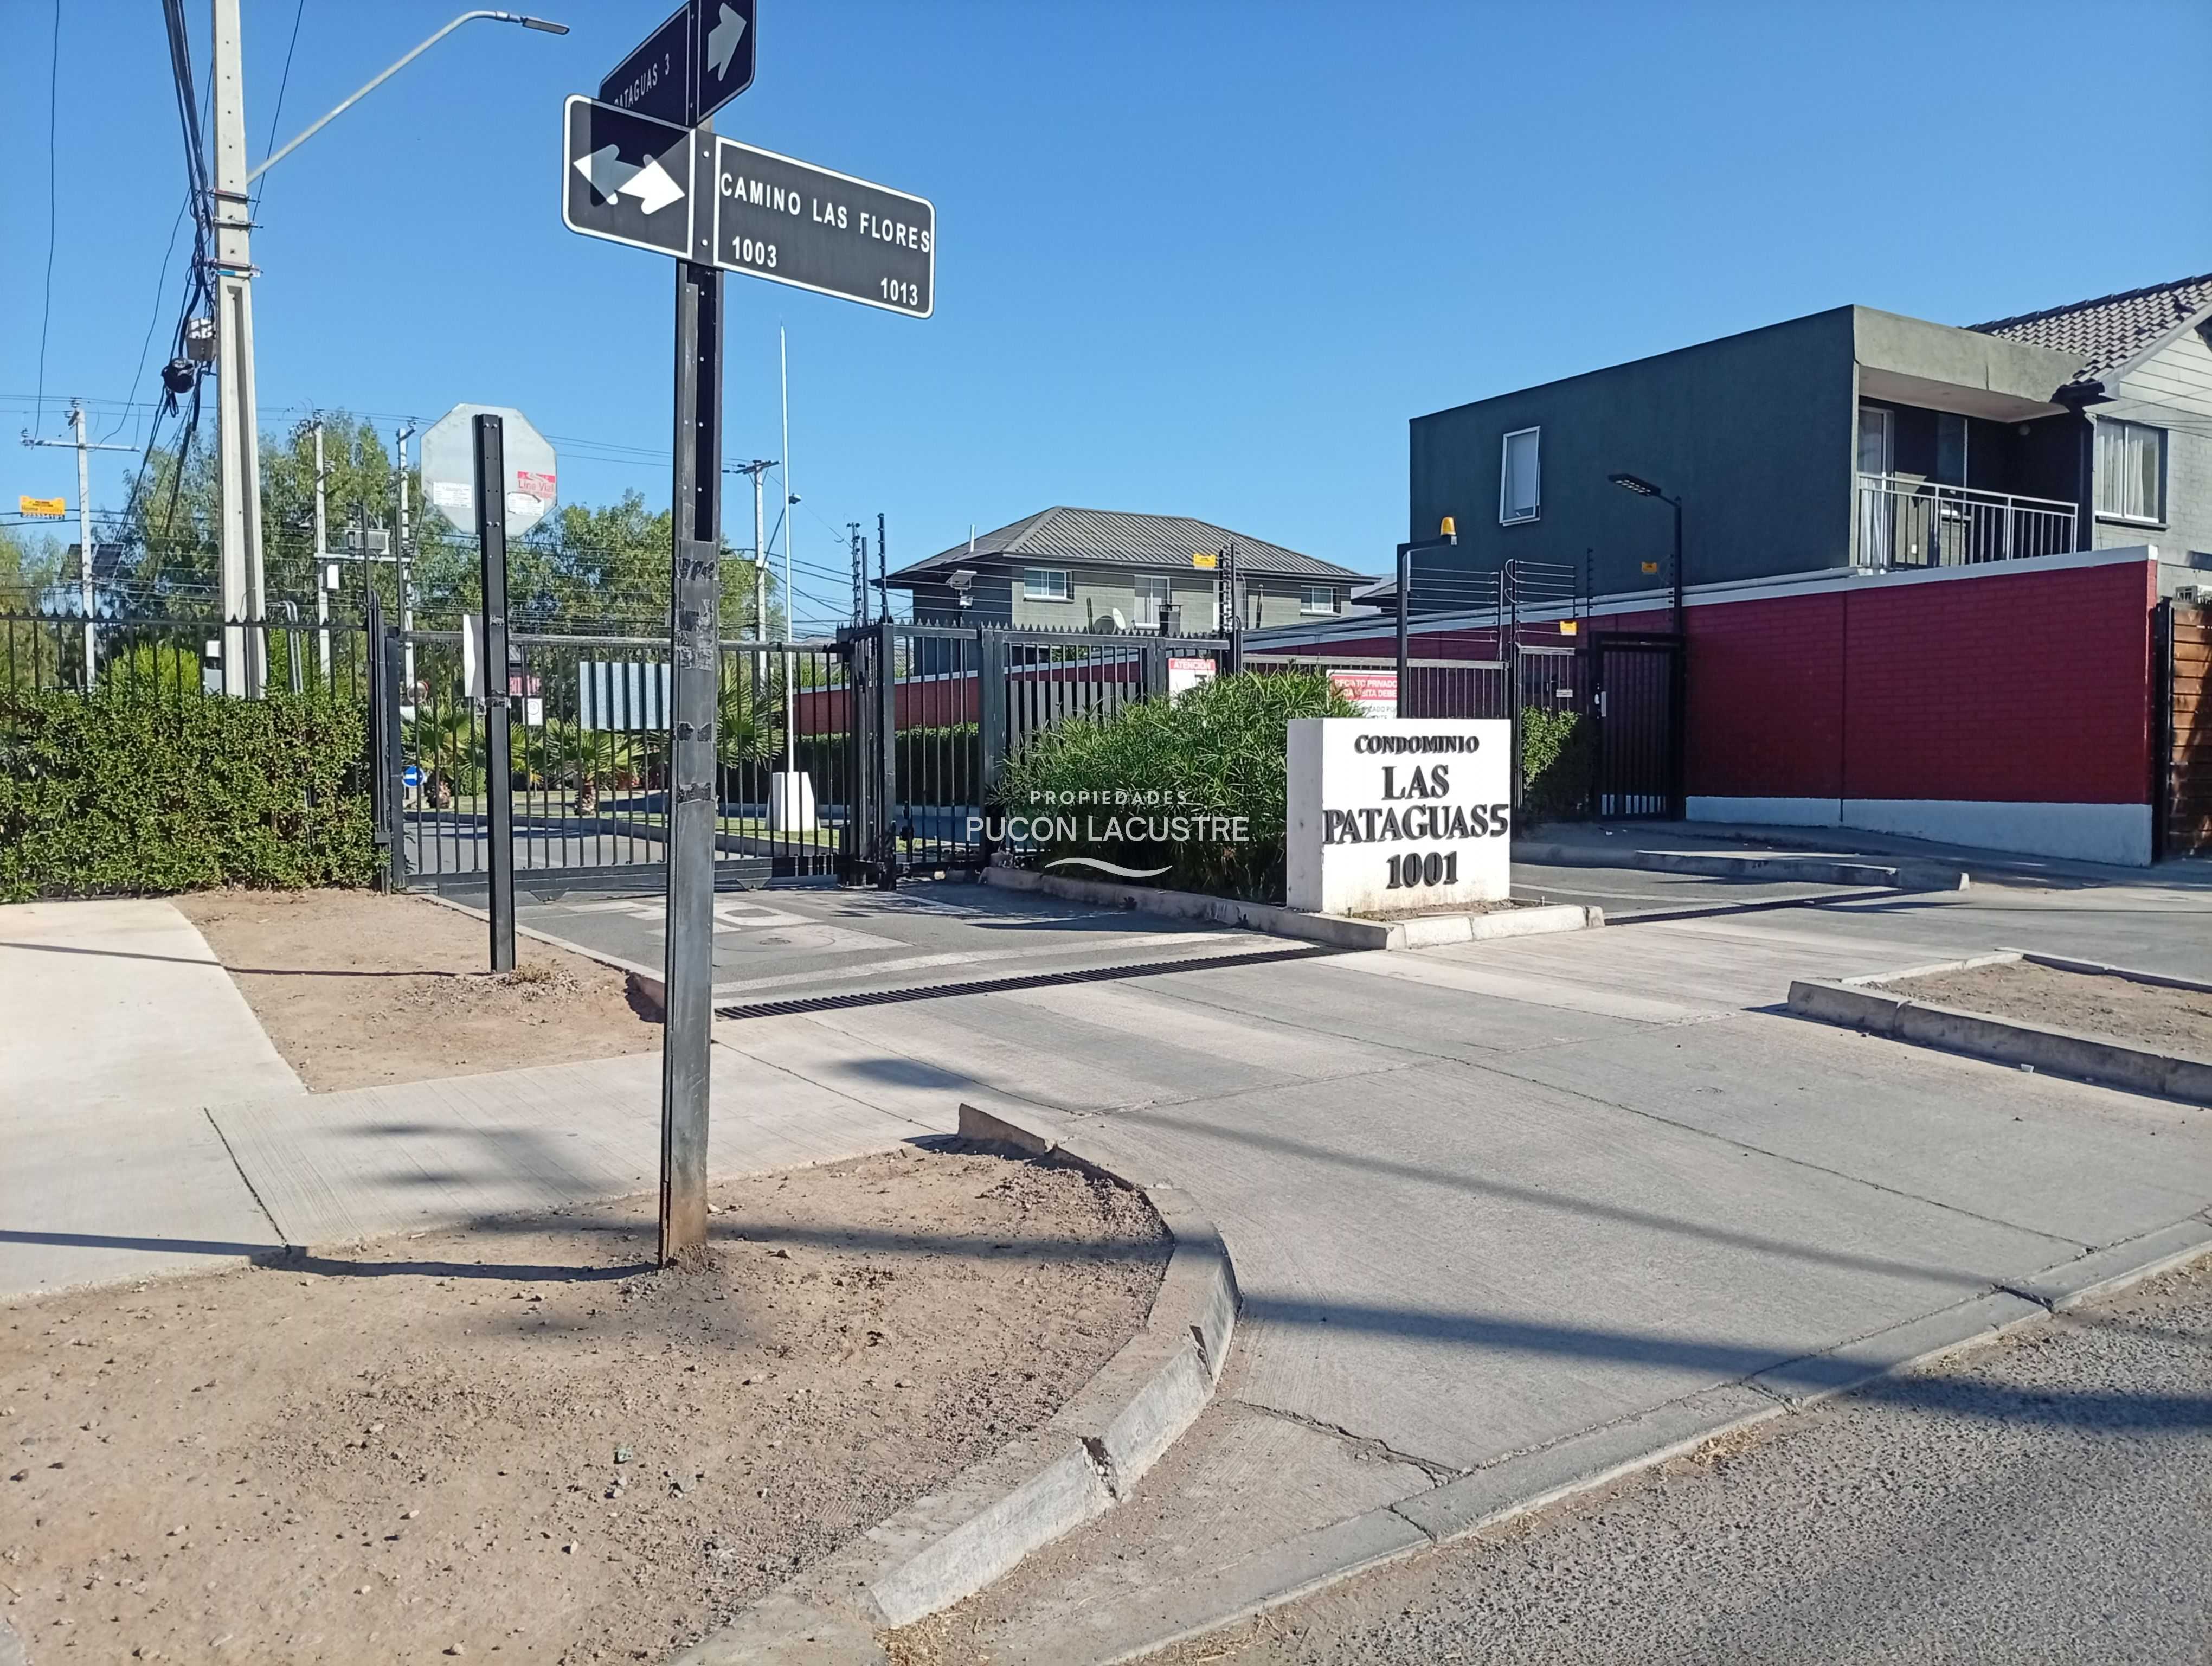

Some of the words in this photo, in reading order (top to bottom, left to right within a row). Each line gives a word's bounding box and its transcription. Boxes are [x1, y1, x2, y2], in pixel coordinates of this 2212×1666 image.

[614, 62, 658, 108] ATAGUAS
[665, 53, 670, 76] 3
[721, 172, 801, 216] CAMINO
[813, 198, 848, 229] LAS
[860, 213, 930, 253] FLORES
[732, 236, 777, 268] 1003
[880, 277, 918, 306] 1013
[1354, 734, 1480, 754] CONDOMINIO
[1381, 764, 1450, 801] LAS
[1386, 850, 1459, 890] 1001
